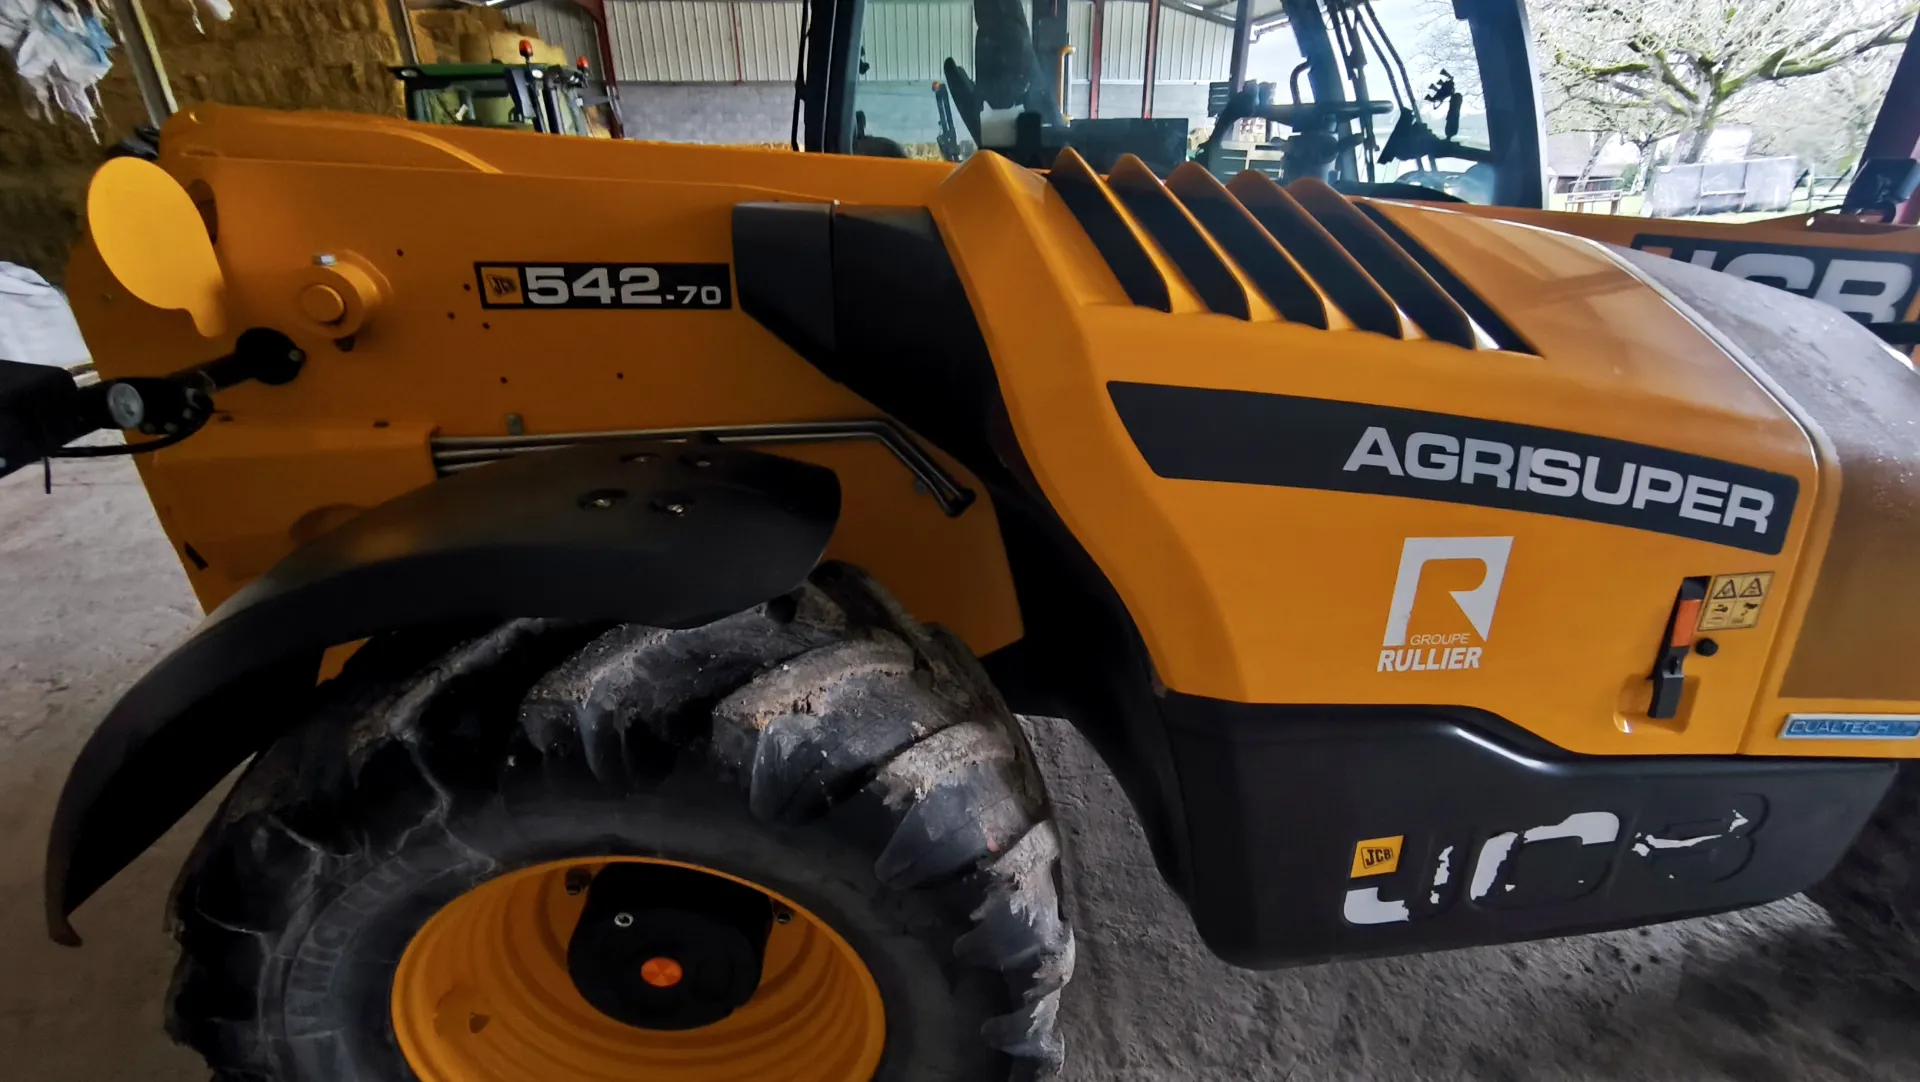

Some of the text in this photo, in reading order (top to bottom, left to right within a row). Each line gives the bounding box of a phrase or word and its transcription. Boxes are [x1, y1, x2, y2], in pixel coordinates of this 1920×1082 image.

[1343, 426, 1775, 534] AGRISUPER
[1410, 633, 1470, 645] GROUPE
[1377, 647, 1482, 672] RULLIER
[1366, 848, 1391, 866] JCB
